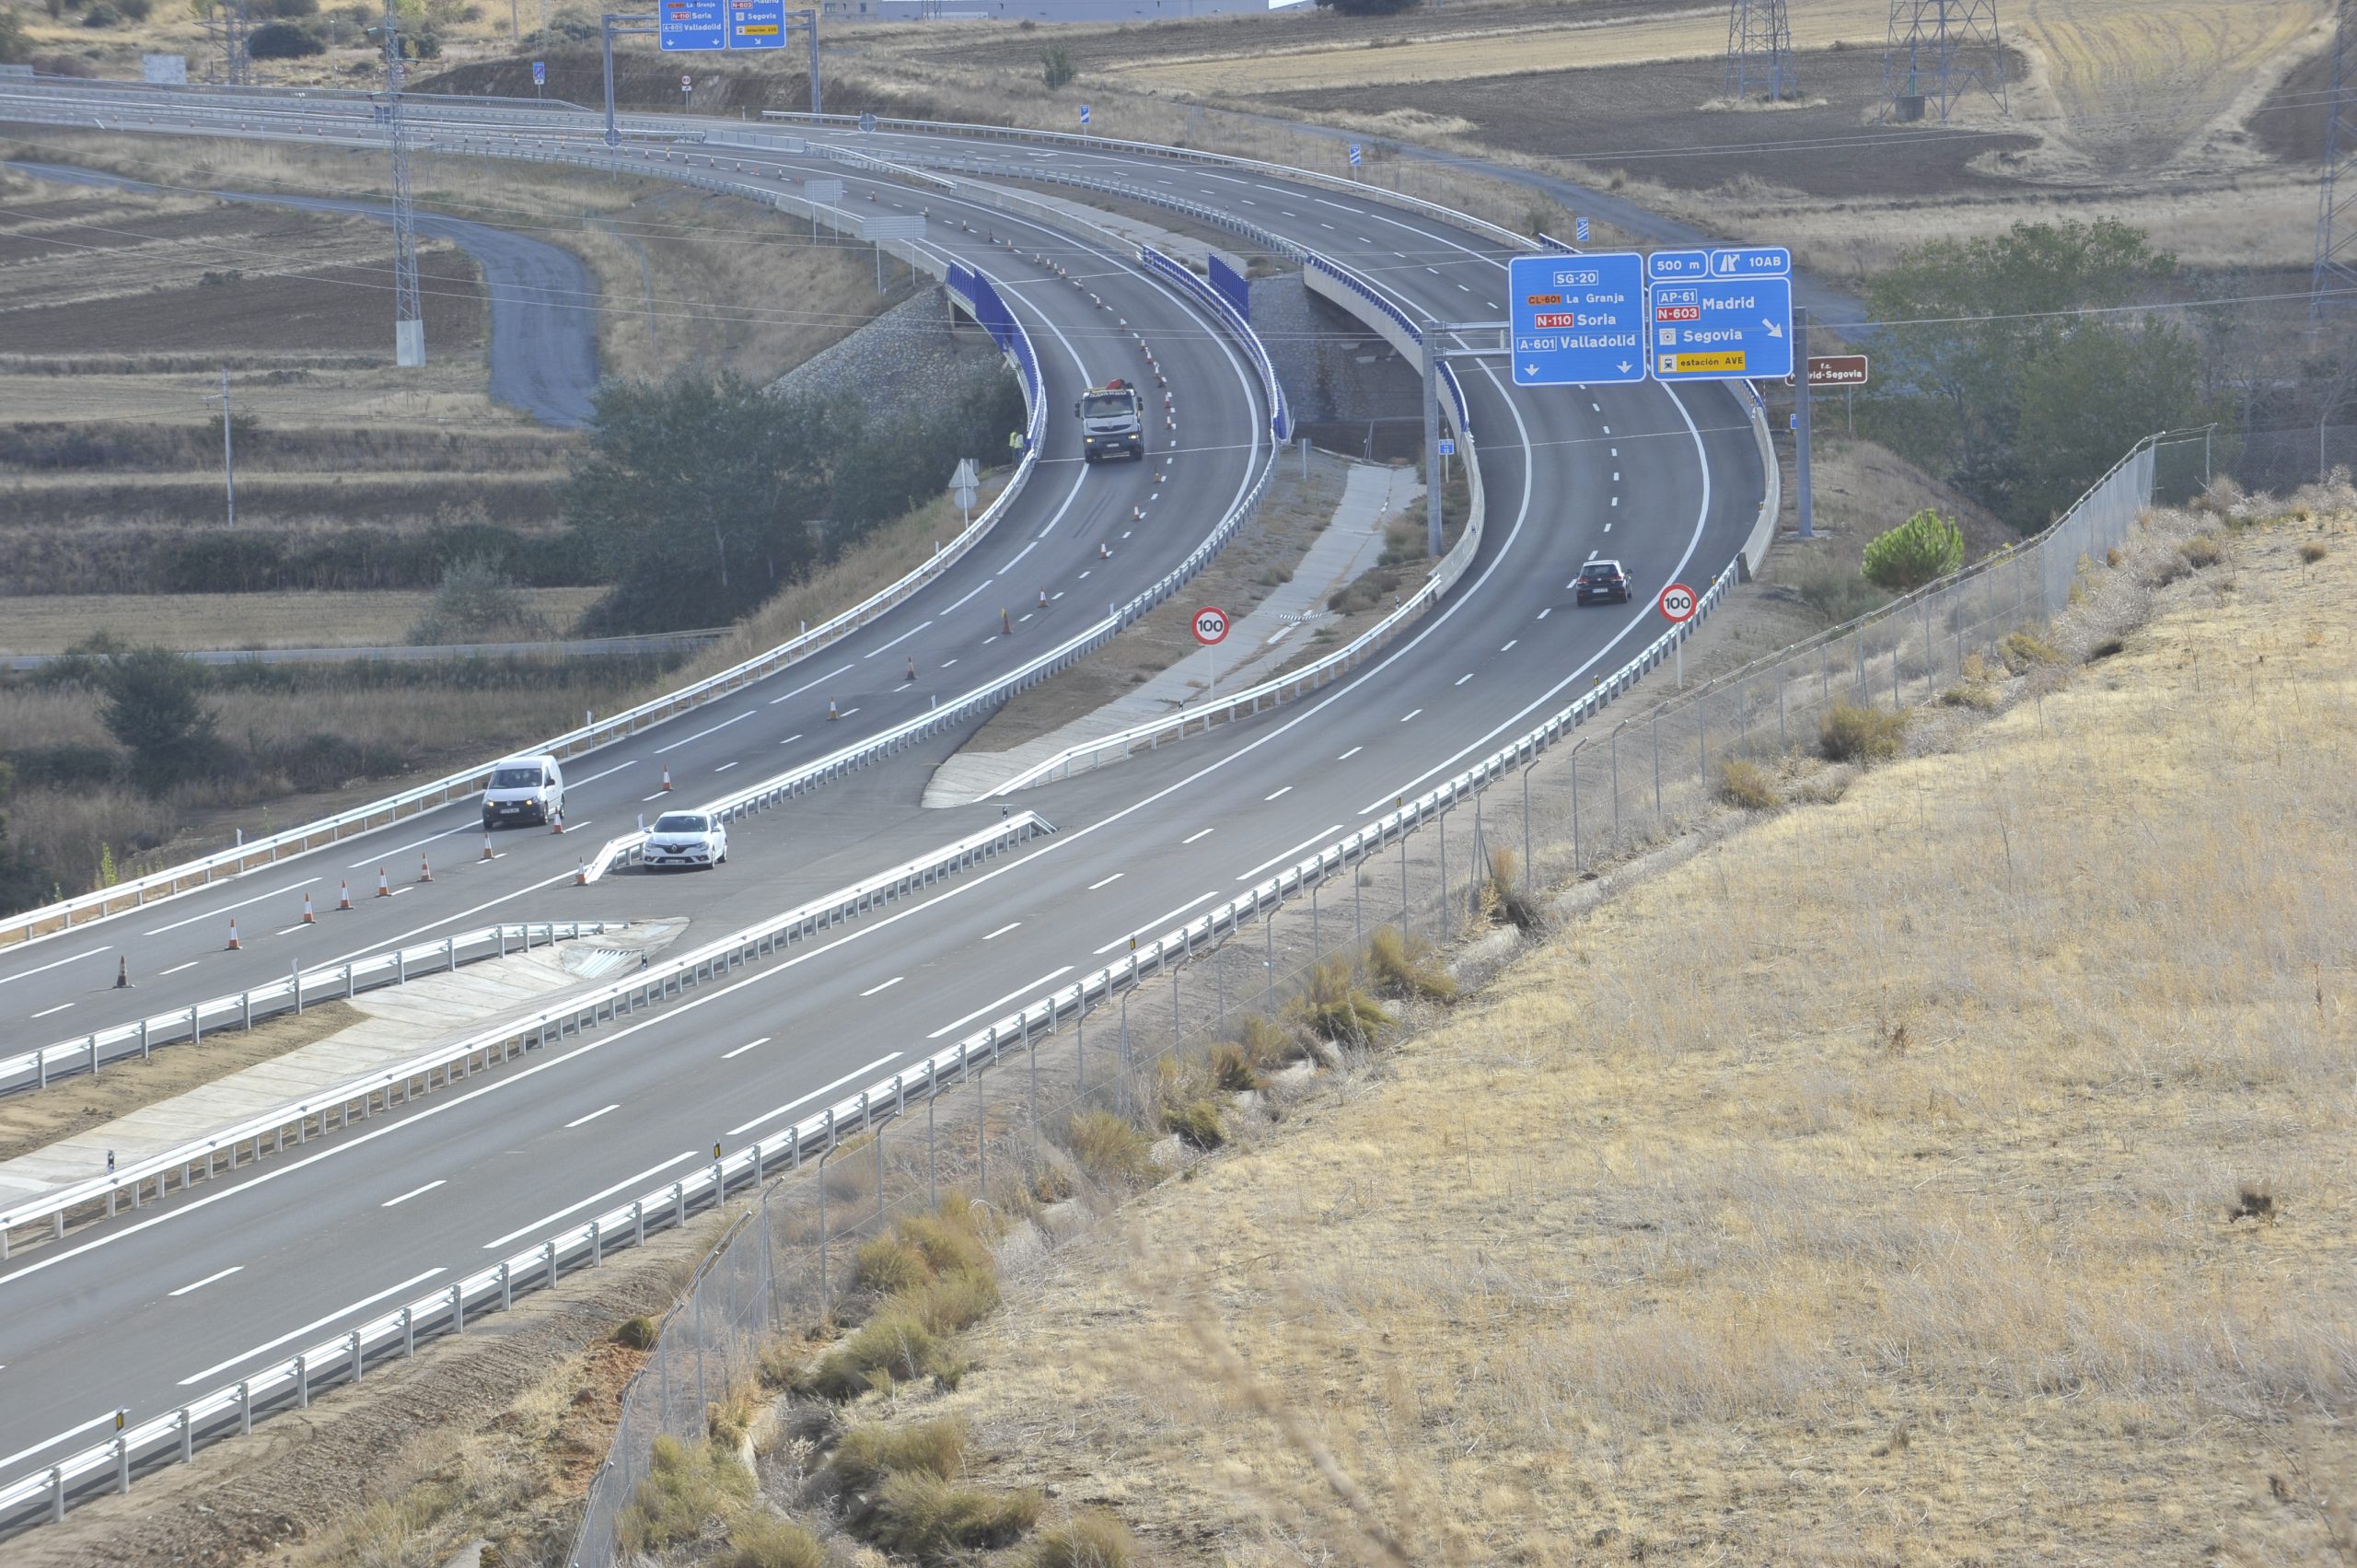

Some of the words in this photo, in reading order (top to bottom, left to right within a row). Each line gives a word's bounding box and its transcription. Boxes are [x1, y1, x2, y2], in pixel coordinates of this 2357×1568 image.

[748, 13, 776, 21] Segovia
[1656, 261, 1682, 271] 500
[1689, 261, 1701, 270] m
[1748, 256, 1782, 267] 10AB
[1556, 273, 1596, 285] SG-20
[1528, 295, 1561, 305] CL-601
[1566, 295, 1579, 304] La
[1585, 293, 1624, 304] Granja
[1660, 291, 1695, 303] AP-61
[1702, 296, 1755, 310] Madrid
[1658, 308, 1698, 319] N-603
[1537, 315, 1572, 327] N-110
[1577, 313, 1617, 326] Soria
[1683, 328, 1743, 343] Segovia
[1519, 338, 1555, 350] A-601
[1560, 334, 1636, 349] Valladolid
[1680, 357, 1720, 366] estación
[1724, 356, 1744, 366] AVE
[1665, 596, 1691, 610] 100
[1197, 618, 1225, 633] 100
